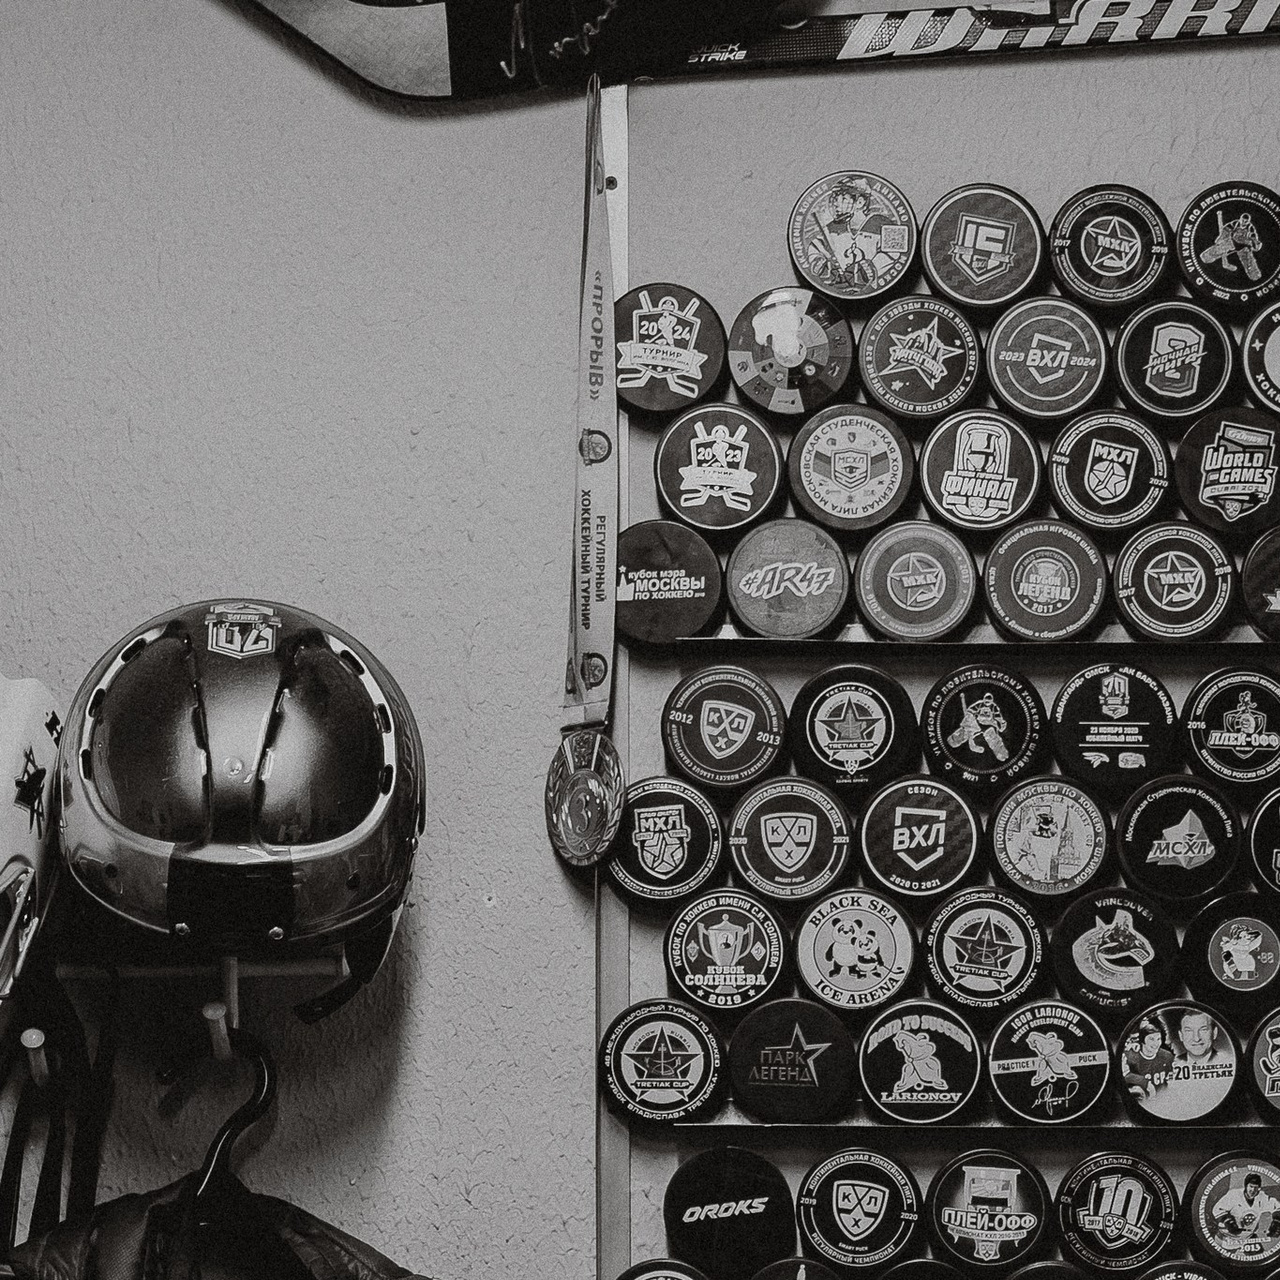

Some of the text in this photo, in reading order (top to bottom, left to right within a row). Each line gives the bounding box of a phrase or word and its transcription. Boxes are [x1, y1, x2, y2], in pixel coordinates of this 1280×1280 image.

[688, 50, 747, 62] STRIKE
[1097, 234, 1131, 254] МХЛ
[999, 350, 1025, 362] 2023
[1026, 349, 1069, 369] ВХЛ
[1070, 356, 1097, 367] 2024
[1094, 444, 1132, 465] МХЛ
[1205, 445, 1265, 470] WORLD
[1219, 466, 1273, 485] GAMES
[945, 477, 1013, 500] ФИНАЛ
[581, 490, 592, 575] ХОККЕЙНЫЙ
[595, 515, 607, 603] РЕГУЛЯРНЫЙ
[636, 576, 706, 591] МОСКВЫ
[1032, 603, 1054, 614] 2017
[668, 710, 694, 725] 2012
[1187, 721, 1206, 730] 2016
[756, 731, 781, 745] 2013
[908, 786, 939, 797] СЕЗОН
[893, 822, 946, 852] ВХЛ
[1151, 840, 1213, 857] МСХЛ
[920, 878, 941, 888] 2021
[809, 896, 900, 929] BLACK SEA
[683, 897, 780, 969] ХОККЕЮ ИМЕНИ СОЛНЦЕВА
[707, 965, 745, 975] КУБОК
[685, 973, 767, 987] СОЛНЦЕВА
[814, 974, 903, 1006] ICE ARENA
[1010, 1007, 1081, 1030] IGOR LARIONOV
[760, 1050, 806, 1065] ПАРК
[1077, 1054, 1098, 1063] PUCK
[1191, 1070, 1234, 1080] ТРЕТЬЯК
[636, 1081, 673, 1089] TRETIAK
[682, 1197, 769, 1223] OROKS
[900, 1212, 918, 1221] 2020
[943, 1208, 1036, 1231] ПЛЕЙ-ОФФ
[810, 1232, 853, 1263] РЕГУЛЯРНЫЙ
